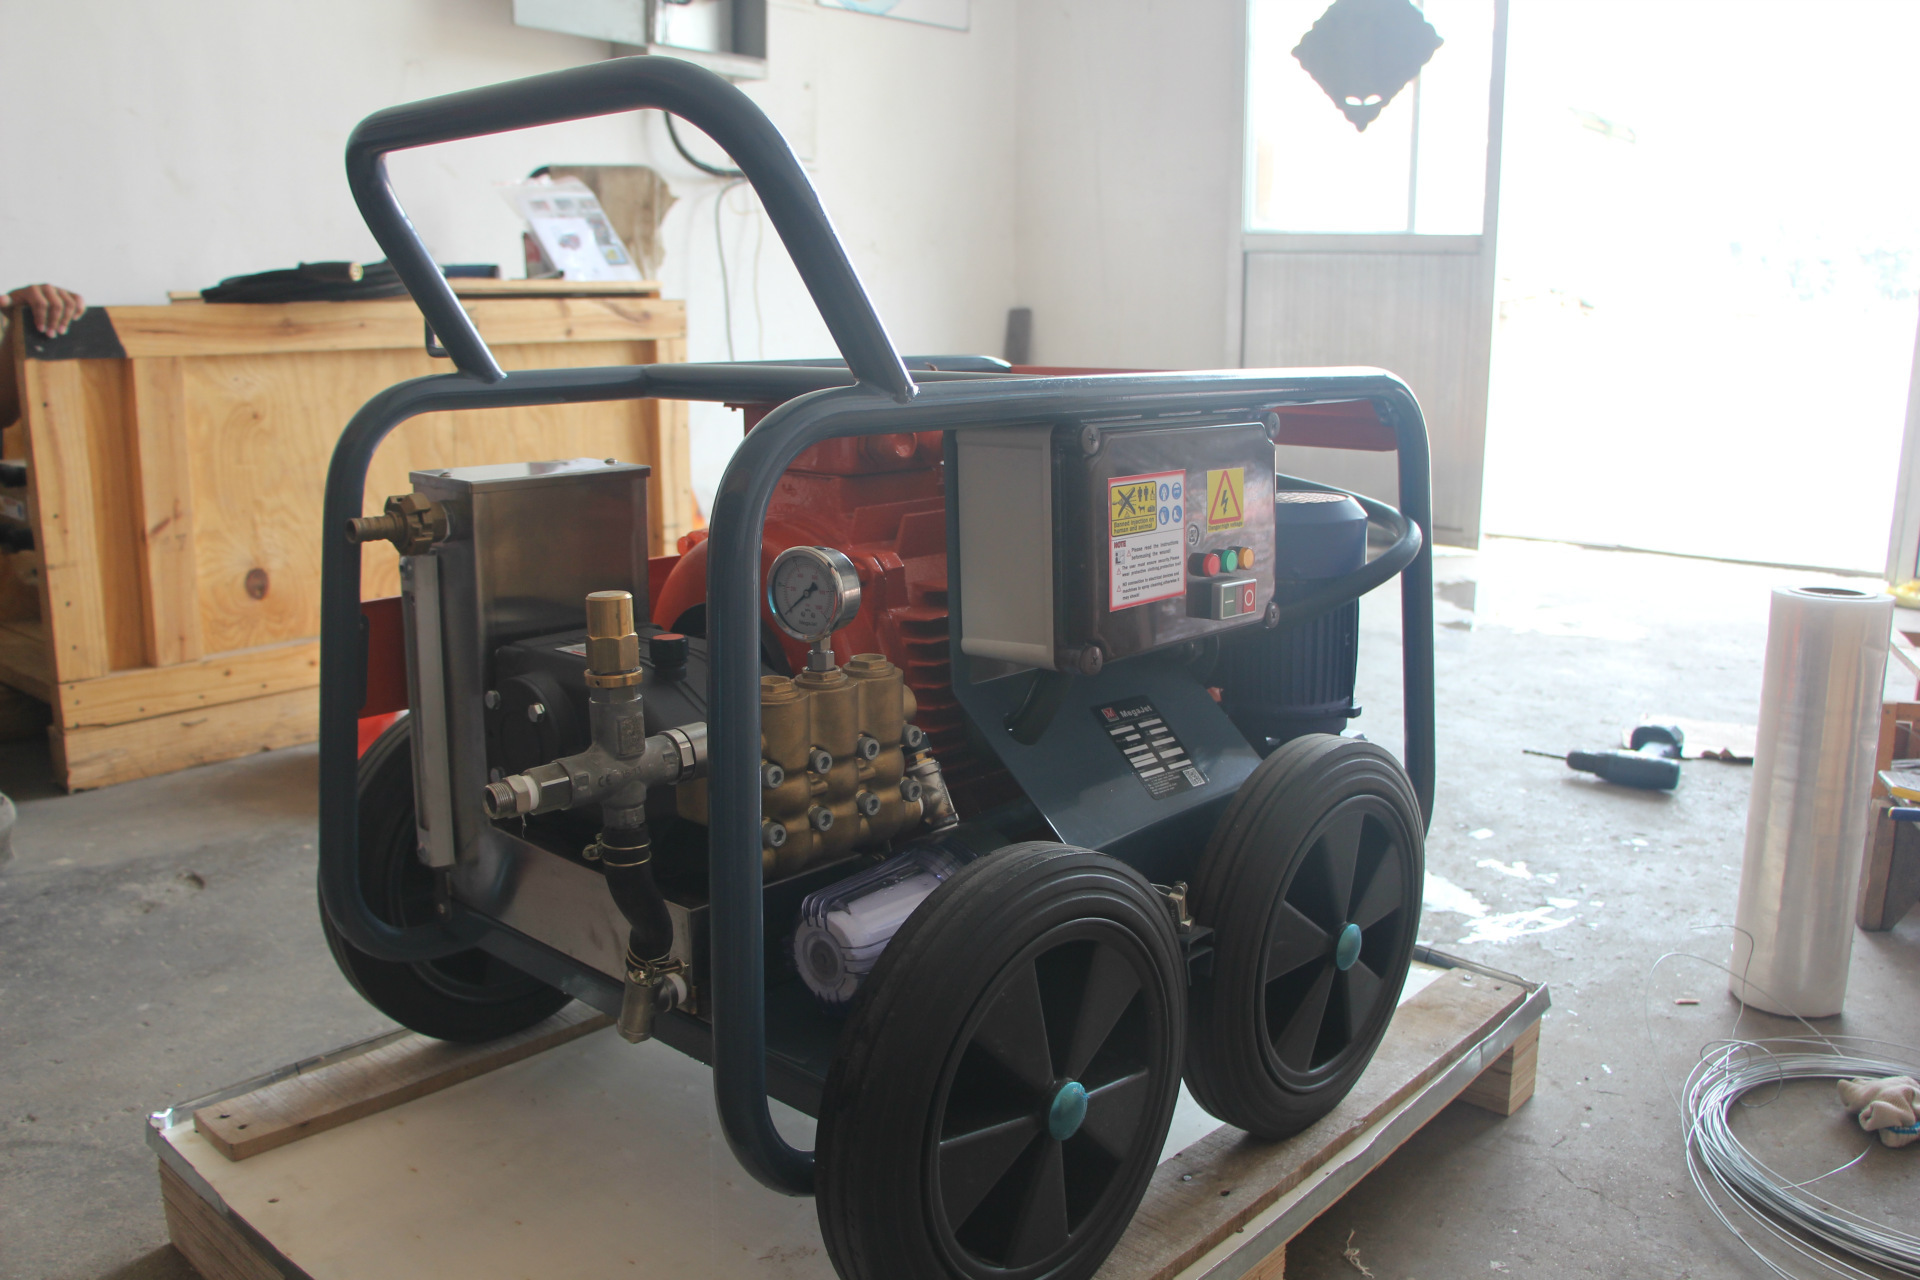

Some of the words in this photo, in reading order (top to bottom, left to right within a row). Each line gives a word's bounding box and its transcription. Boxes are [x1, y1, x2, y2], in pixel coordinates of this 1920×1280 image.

[1114, 520, 1130, 528] Banned
[1114, 540, 1126, 549] NOTE
[1119, 704, 1153, 718] MegaJet
